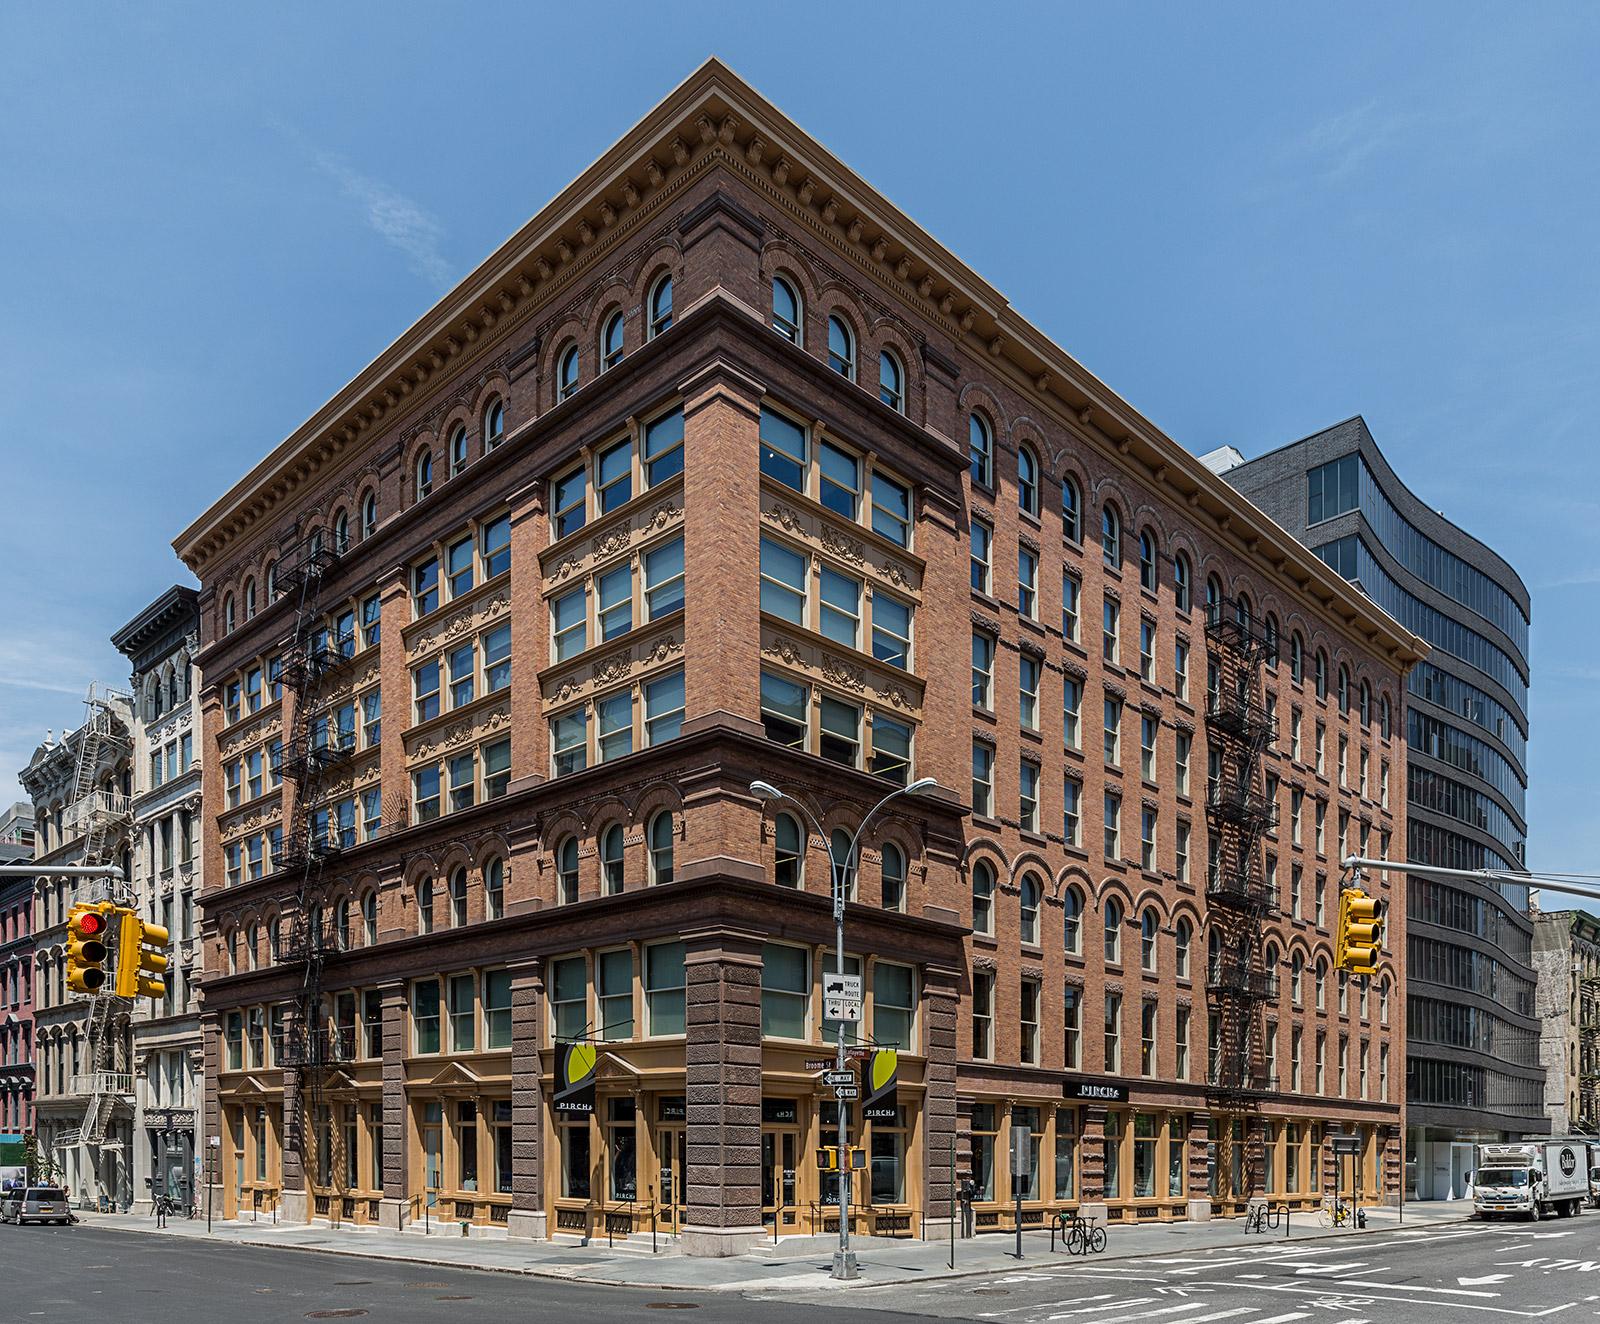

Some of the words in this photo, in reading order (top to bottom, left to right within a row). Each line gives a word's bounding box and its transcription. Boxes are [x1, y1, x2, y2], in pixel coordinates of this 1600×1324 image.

[844, 1000, 860, 1008] LOCAL
[806, 1061, 824, 1069] Broome
[558, 1102, 589, 1110] PIRCH
